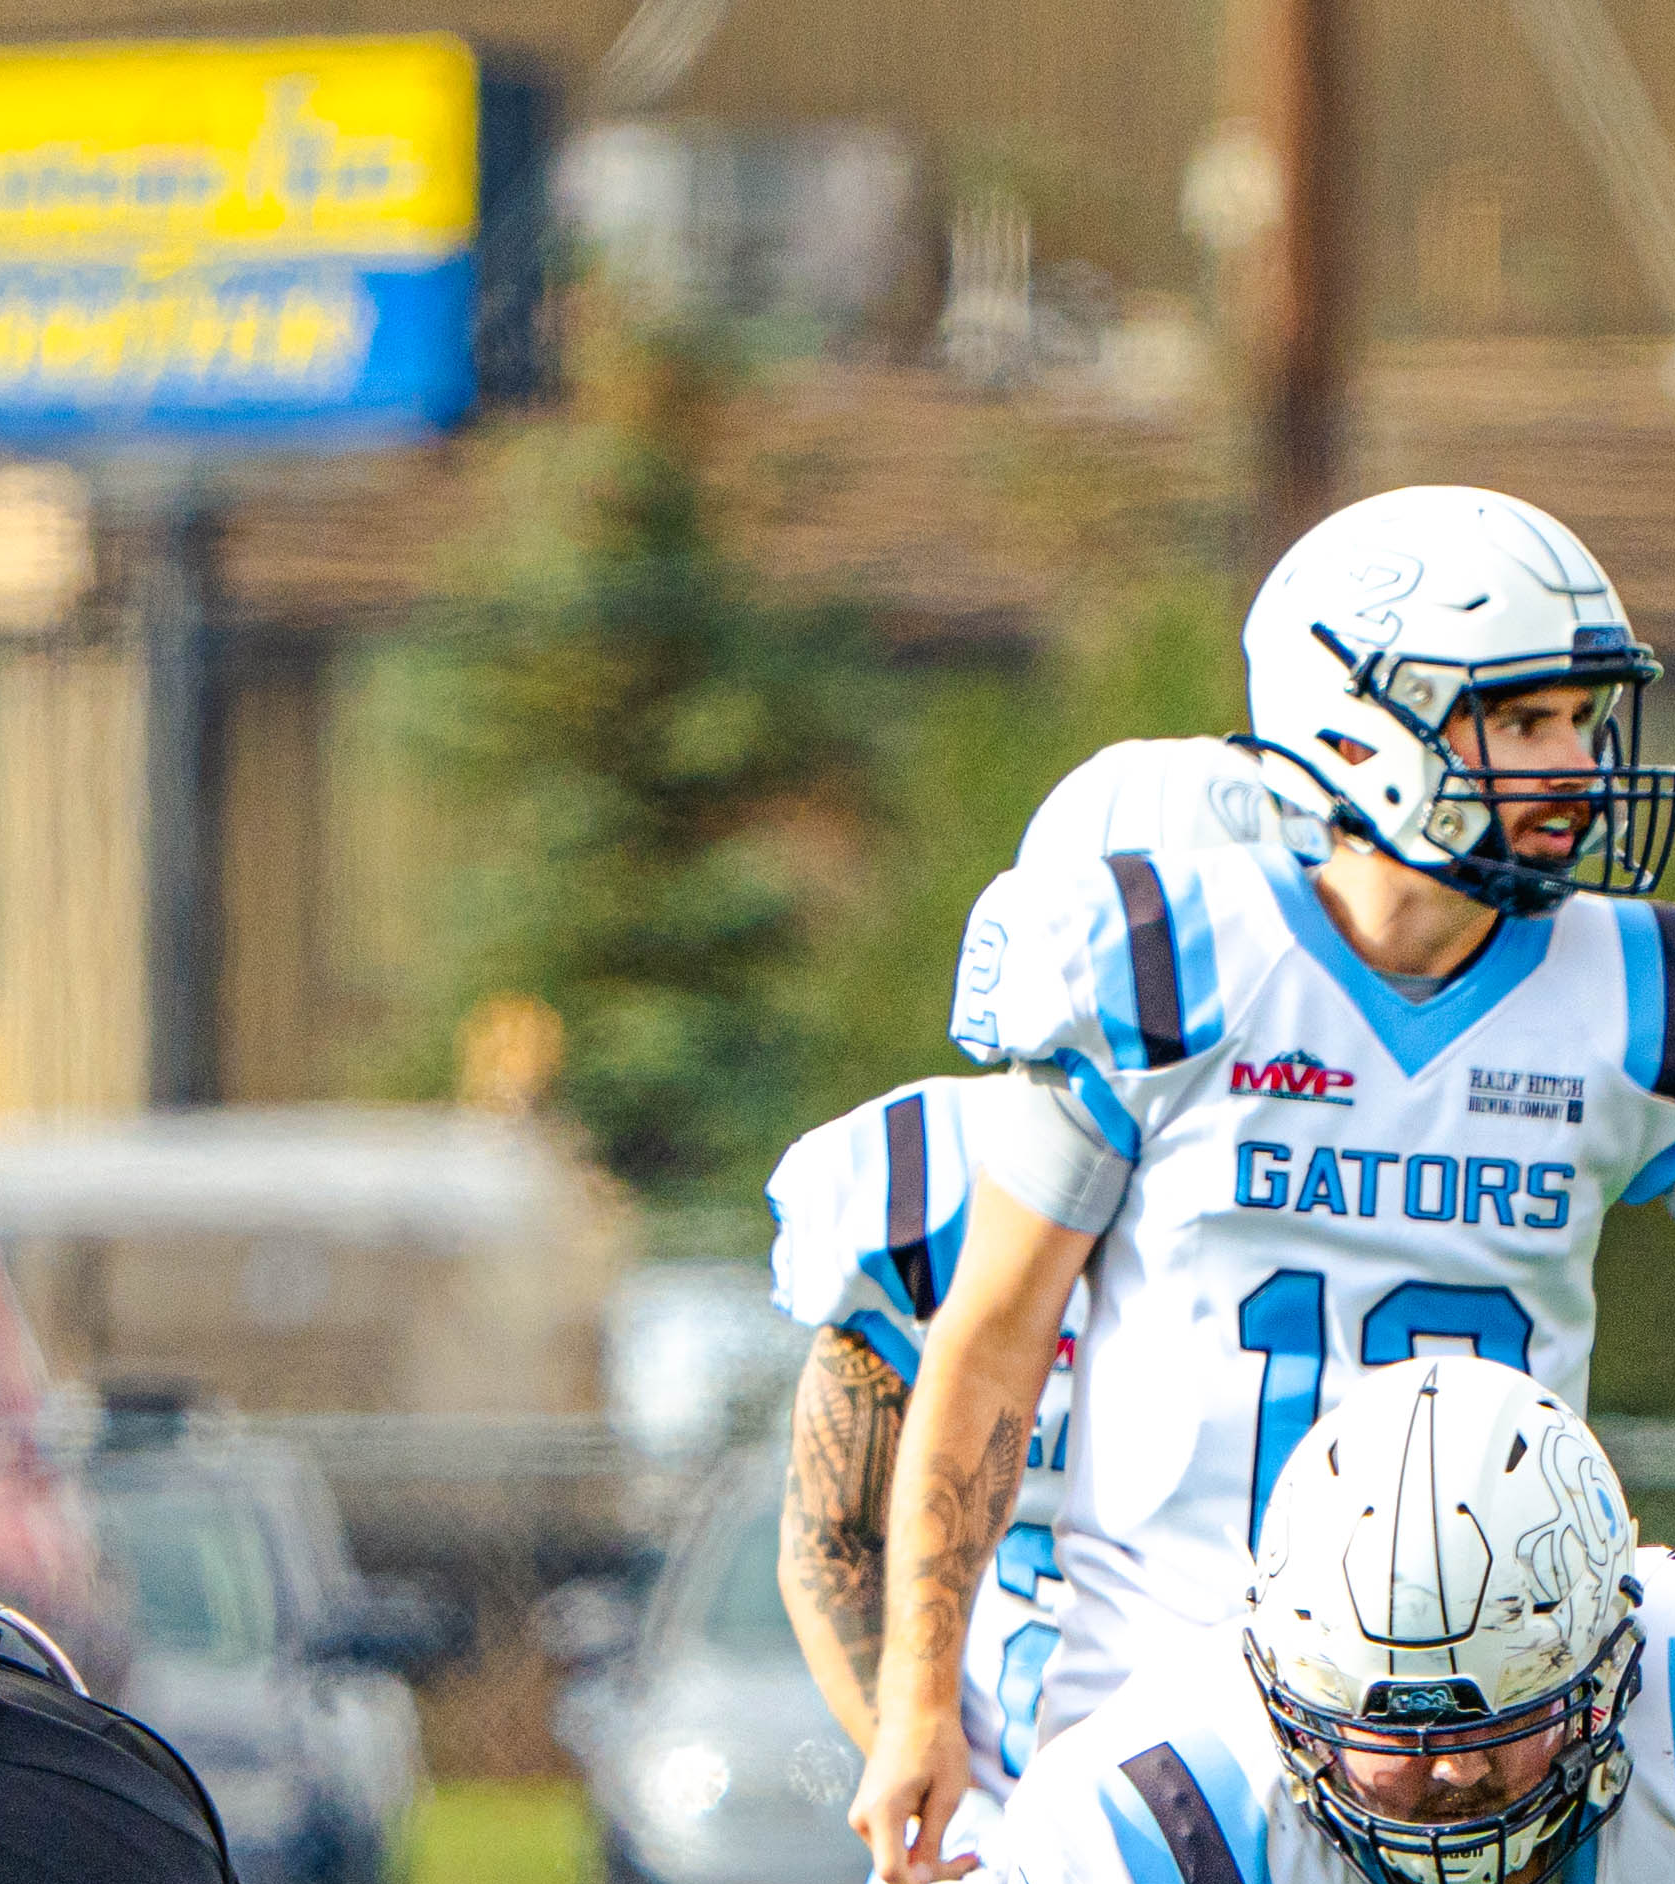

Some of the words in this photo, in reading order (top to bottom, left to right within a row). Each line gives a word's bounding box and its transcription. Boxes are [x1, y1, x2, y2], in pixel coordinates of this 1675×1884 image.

[1230, 1061, 1355, 1096] MVP
[1469, 1067, 1522, 1092] HALF
[1526, 1072, 1586, 1098] HITCH
[1234, 1140, 1576, 1230] GATORS
